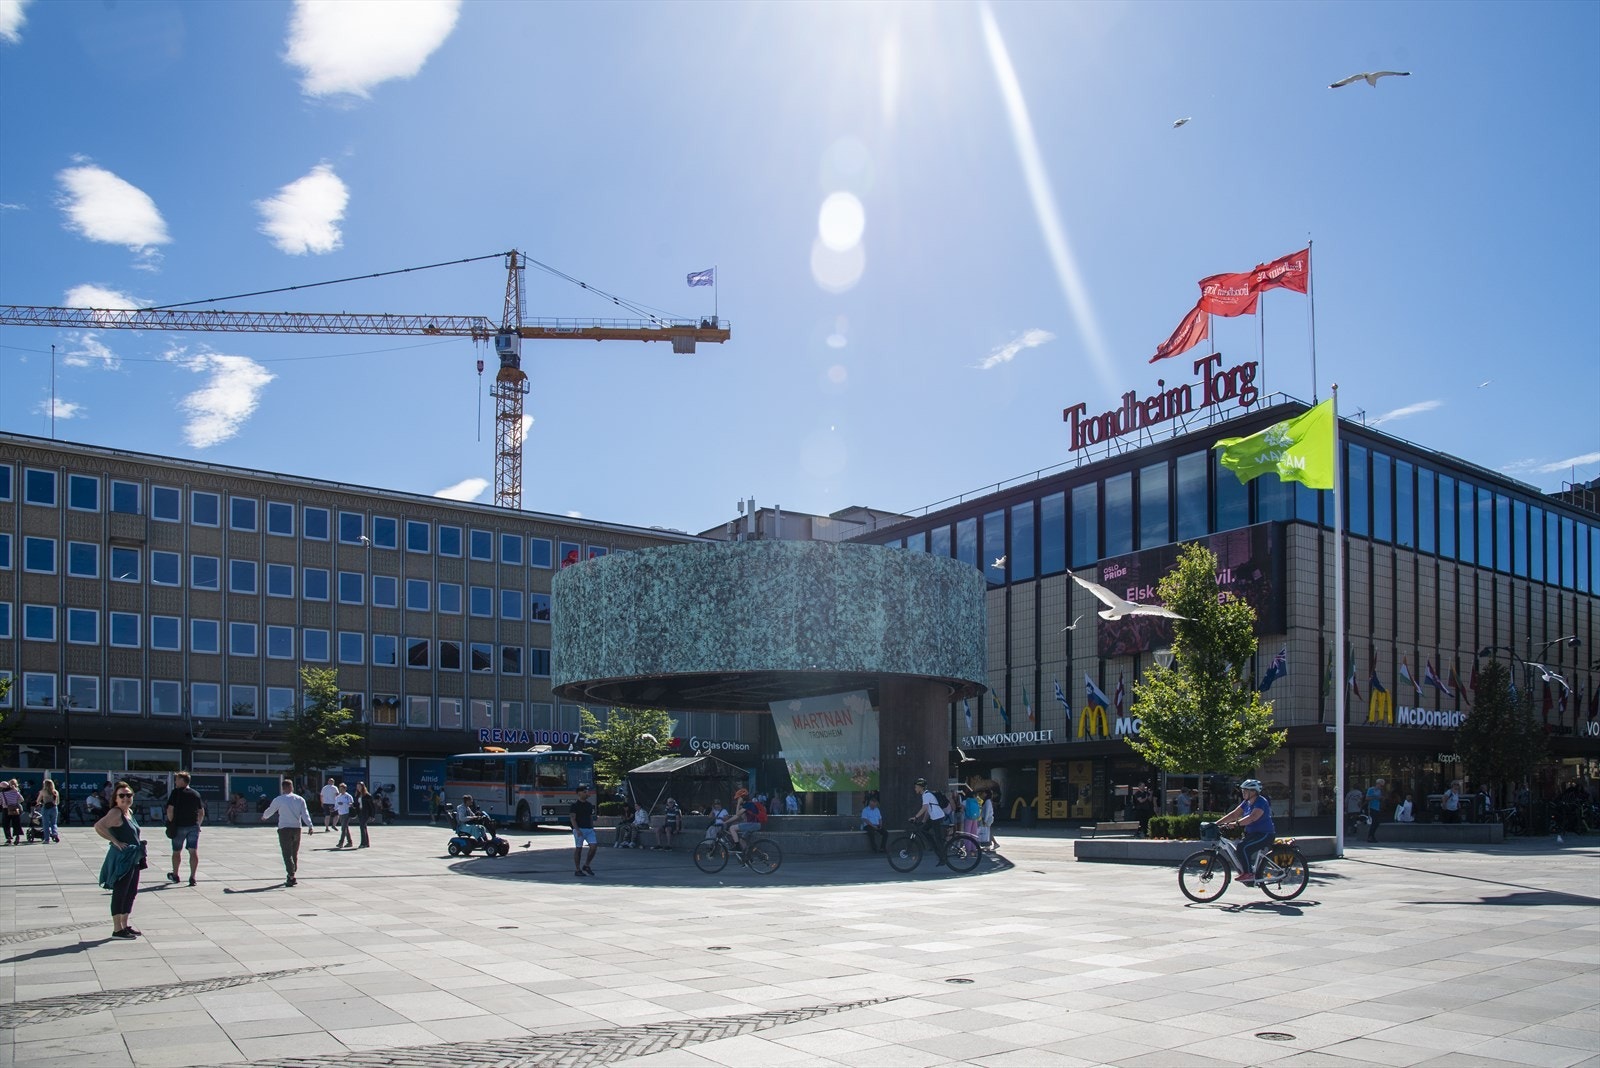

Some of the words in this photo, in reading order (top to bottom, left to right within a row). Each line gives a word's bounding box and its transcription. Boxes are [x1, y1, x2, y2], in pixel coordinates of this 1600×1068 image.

[1063, 379, 1192, 452] Trondheim
[1193, 352, 1259, 407] Torg
[1103, 564, 1119, 574] OSLO
[1104, 568, 1127, 582] PRIDE
[1126, 584, 1155, 602] Elsk
[792, 708, 853, 730] MARTNAN
[1397, 705, 1466, 728] McDonald's
[478, 727, 530, 744] REMA
[533, 730, 571, 745] 1000
[808, 729, 843, 739] TRONDHEIM
[970, 729, 1054, 746] VINMONOPOLET
[701, 740, 721, 750] Clas
[721, 741, 750, 751] Ohlson
[1438, 752, 1461, 765] KappAh
[420, 775, 439, 783] Alltid
[247, 784, 263, 794] DNB
